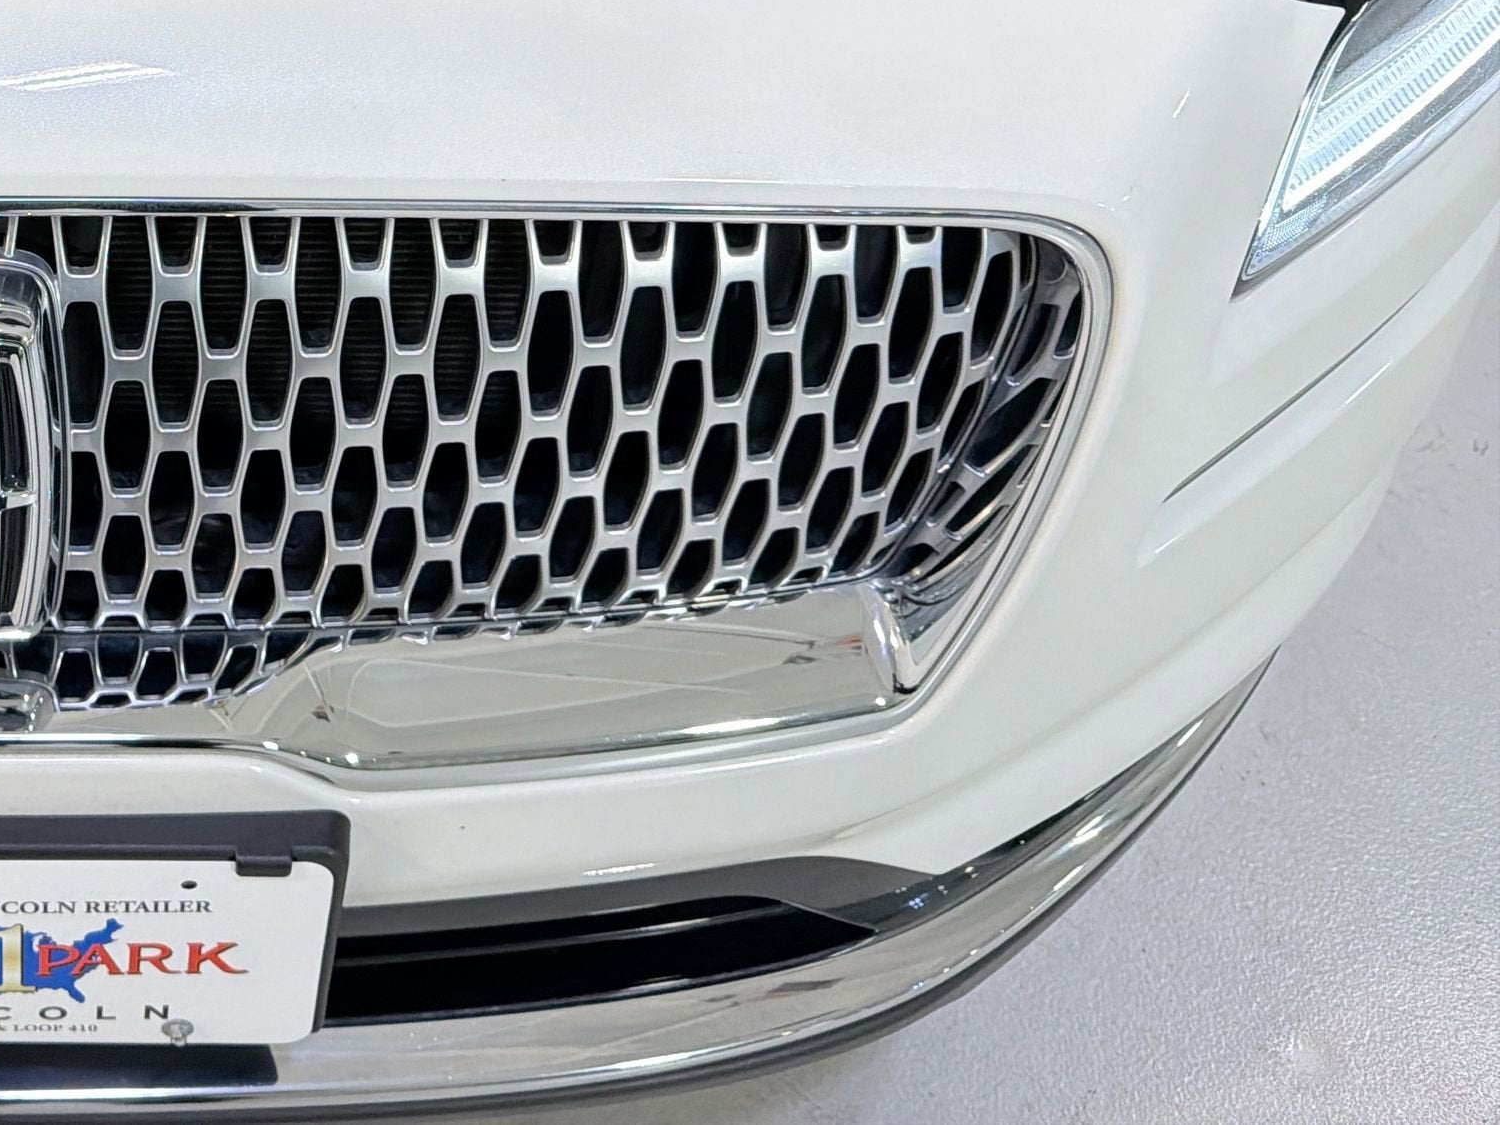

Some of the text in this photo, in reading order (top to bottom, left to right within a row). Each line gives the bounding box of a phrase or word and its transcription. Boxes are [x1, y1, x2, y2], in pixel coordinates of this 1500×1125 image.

[84, 900, 213, 914] RETAILER
[36, 941, 250, 976] PARK
[13, 1024, 63, 1032] LOOP
[68, 1024, 98, 1033] 410
